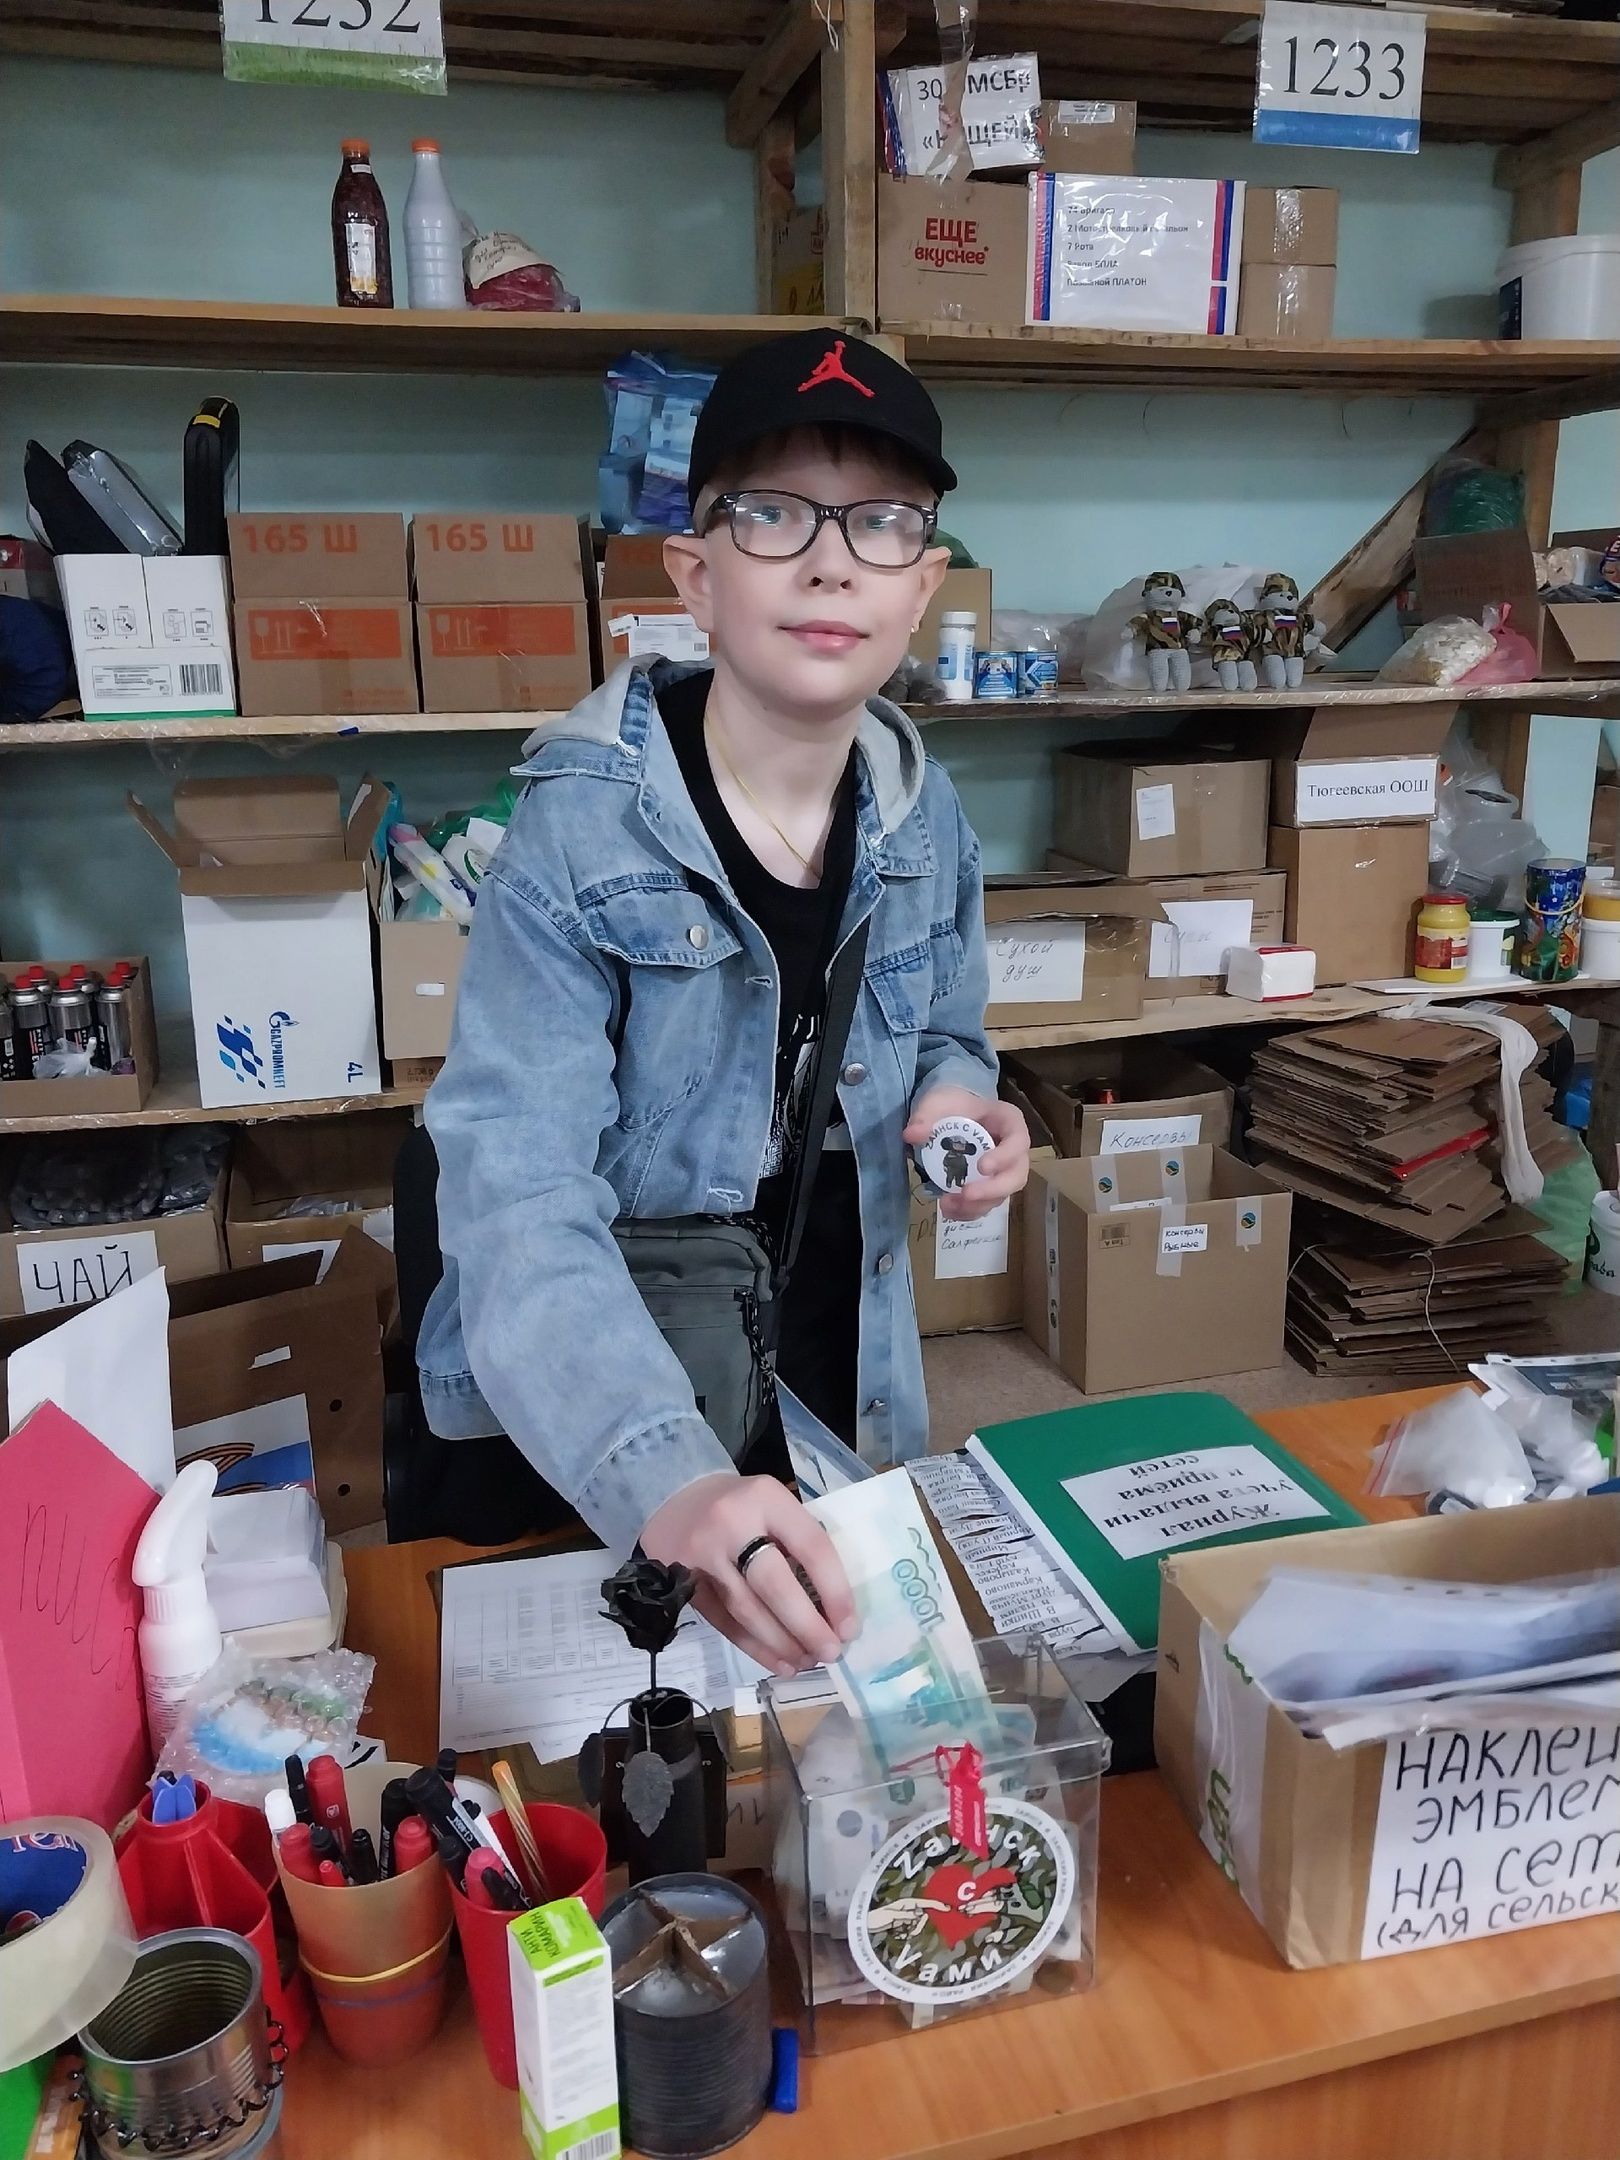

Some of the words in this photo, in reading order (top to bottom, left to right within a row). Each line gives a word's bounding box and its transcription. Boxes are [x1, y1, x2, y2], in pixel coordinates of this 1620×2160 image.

[1284, 36, 1405, 100] 1233
[967, 69, 1031, 95] МСБр
[1080, 206, 1116, 216] бригаа
[925, 217, 978, 248] ЕЩЕ
[1067, 225, 1073, 233] 2
[1067, 242, 1073, 251] 7
[1074, 242, 1095, 251] Рота
[1112, 276, 1148, 287] ПЛАТОН
[242, 524, 309, 552] 165
[323, 523, 359, 553] Ш
[425, 523, 488, 552] 165
[502, 523, 535, 552] Ш
[1307, 784, 1386, 797] Тюгеевская
[1390, 779, 1429, 793] ООШ
[996, 937, 1055, 960] Сухой
[1002, 963, 1044, 984] душ
[347, 1061, 364, 1084] 4L
[32, 1243, 134, 1304] ЧАЙ
[1128, 1455, 1201, 1479] сетей
[1117, 1469, 1220, 1501] приёма
[1103, 1492, 1211, 1529] выдачи
[1159, 1503, 1281, 1538] Журнал
[891, 1557, 947, 1634] 1000
[985, 1577, 1044, 1596] Карманово
[1001, 1608, 1042, 1627] Шипки
[1046, 1605, 1057, 1615] В
[1391, 1856, 1464, 1915] НА
[520, 1927, 543, 1955] АНТИ
[530, 1911, 562, 1958] КОМАРИН
